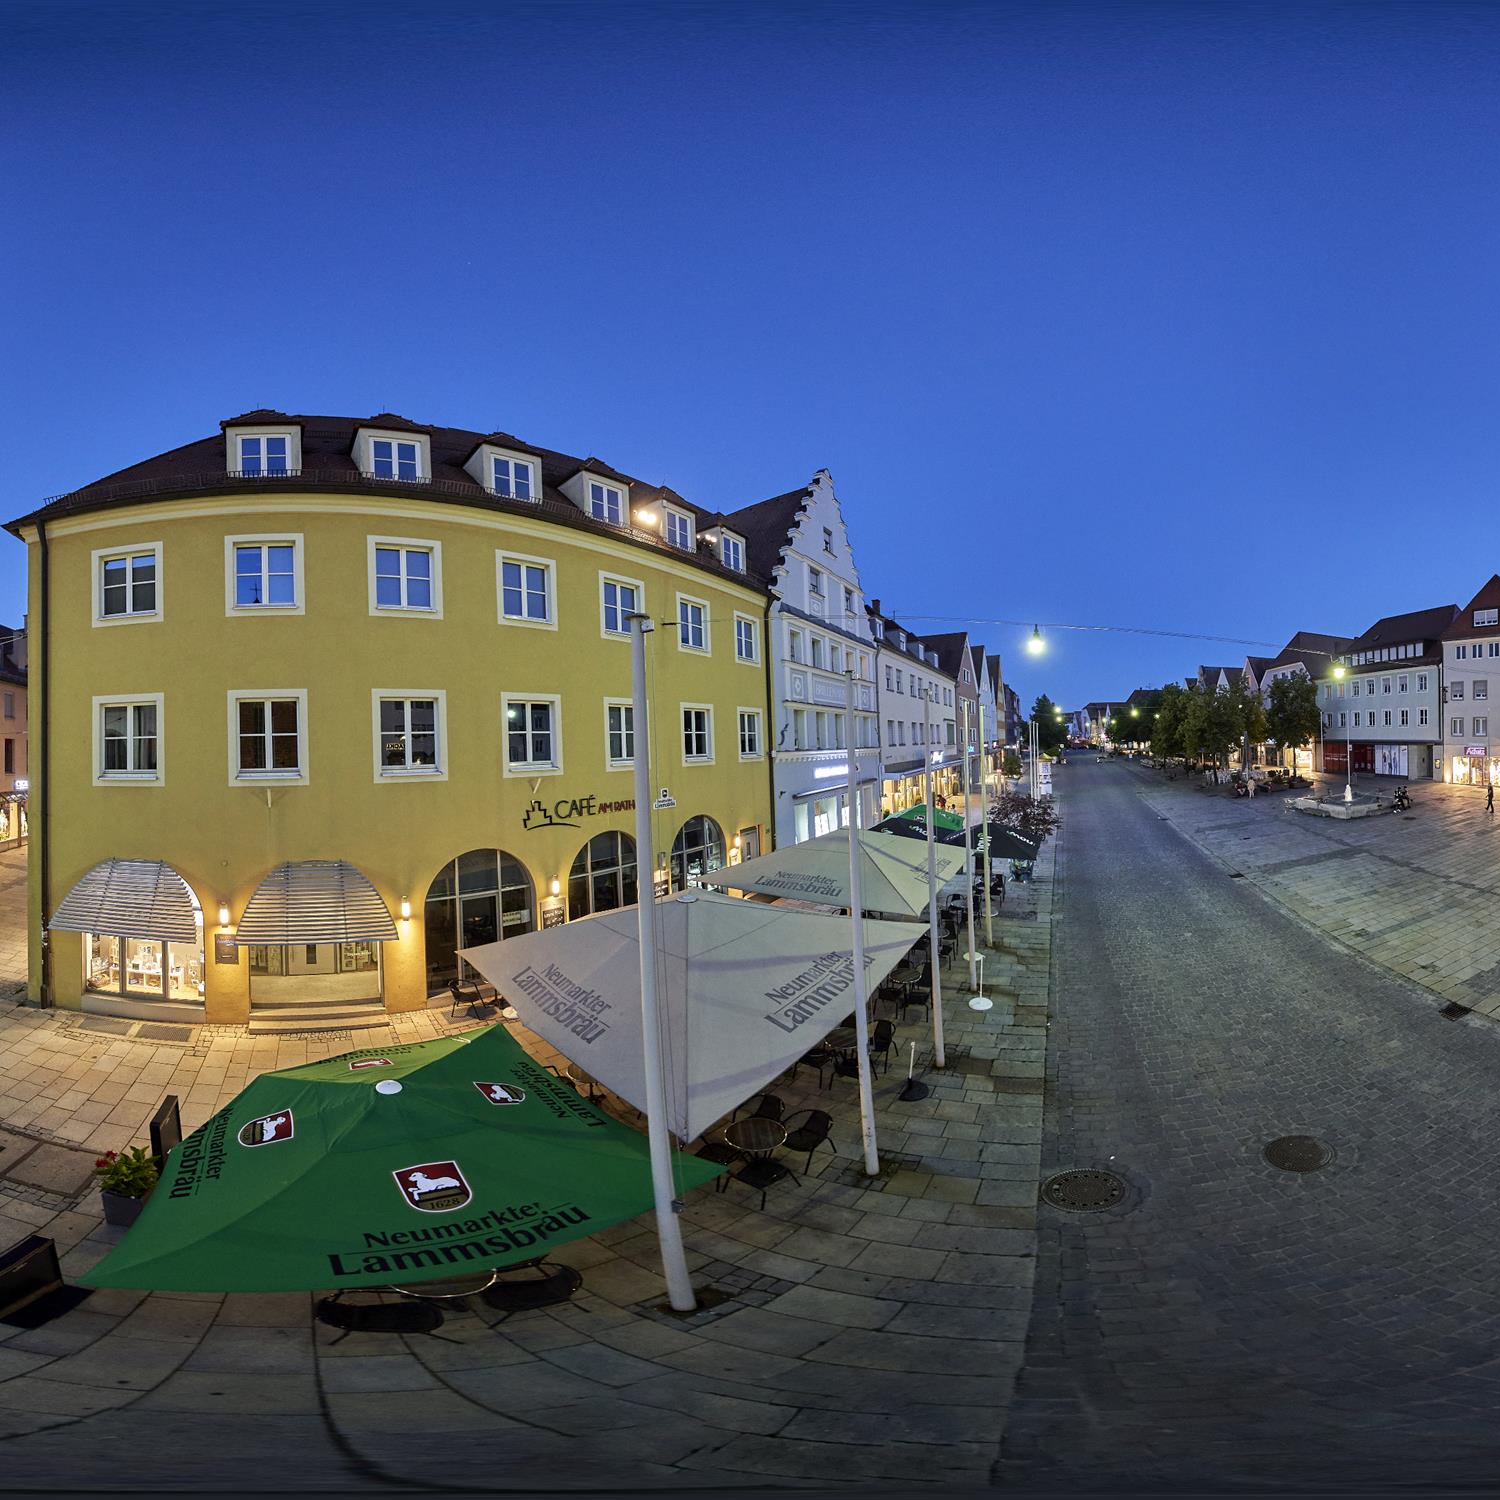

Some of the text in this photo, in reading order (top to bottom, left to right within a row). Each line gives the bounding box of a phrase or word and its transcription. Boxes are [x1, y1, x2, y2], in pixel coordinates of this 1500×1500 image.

[554, 794, 636, 819] CAFÉ AM RATH
[754, 875, 842, 897] Lammsbräu
[774, 870, 837, 885] Neumarkter
[540, 963, 612, 1015] Neumarkter
[764, 951, 843, 1005] Neumarkter
[511, 966, 606, 1044] Lammsbräu
[205, 1107, 233, 1179] Neumarkter
[362, 1201, 544, 1248] Neumarkter
[428, 1197, 461, 1210] 1628
[327, 1204, 592, 1277] Lammsbräu
